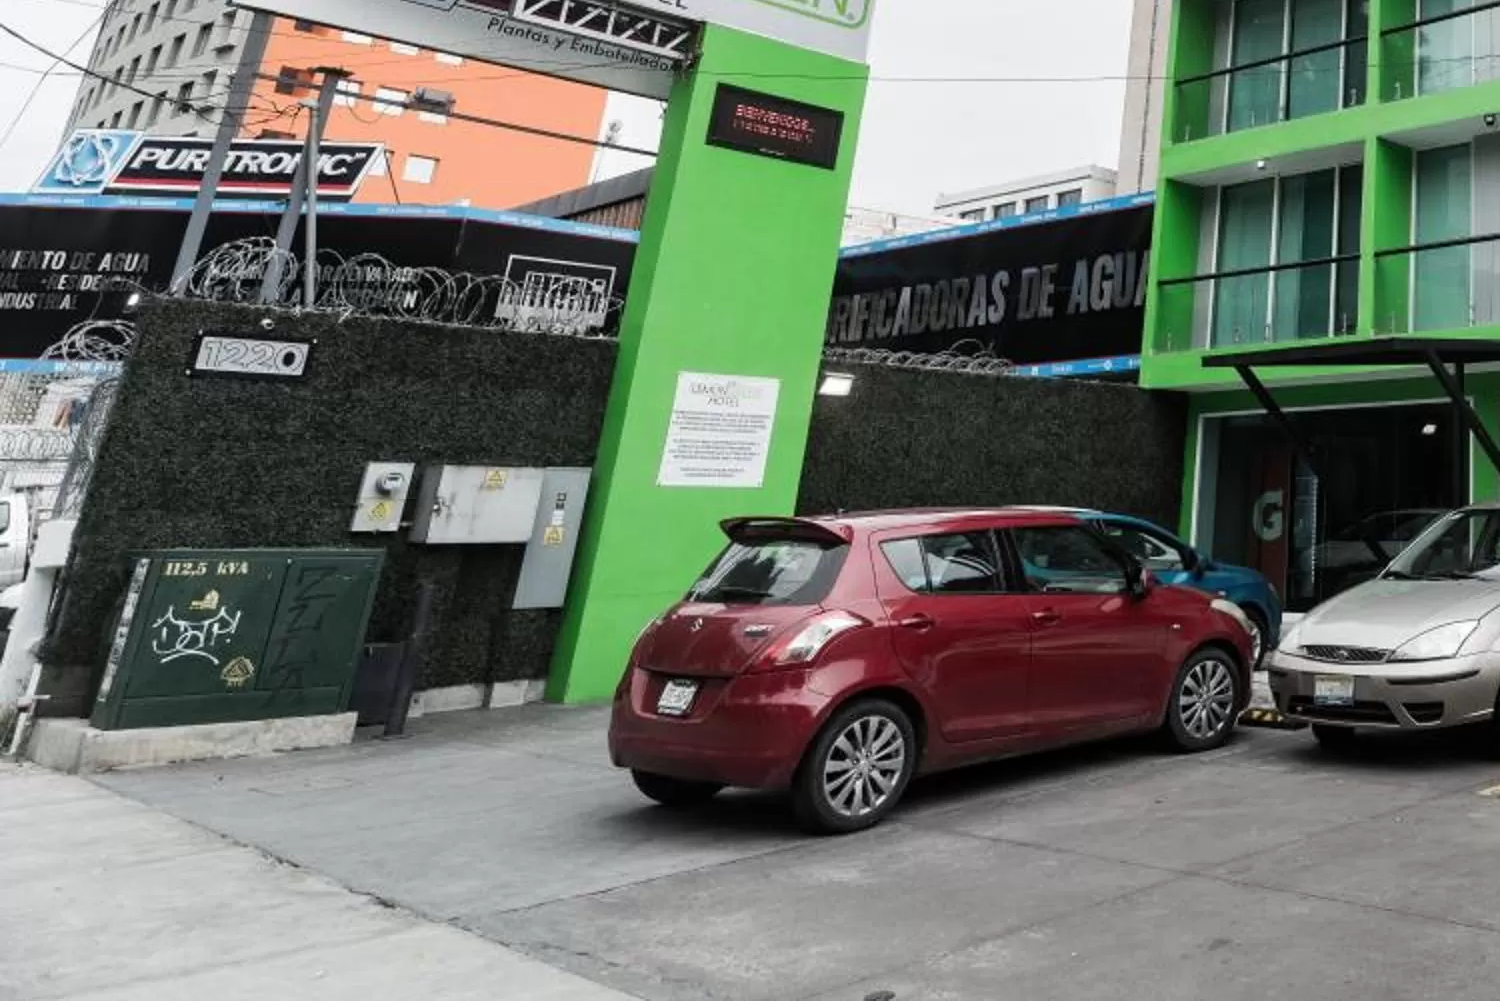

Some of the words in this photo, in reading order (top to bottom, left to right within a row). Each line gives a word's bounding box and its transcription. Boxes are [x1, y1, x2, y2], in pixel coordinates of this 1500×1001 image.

[487, 16, 549, 45] Plantas
[554, 36, 566, 51] y
[68, 251, 97, 271] DE
[97, 252, 150, 273] AGUA
[1015, 262, 1060, 322] DE
[203, 340, 305, 373] 1220
